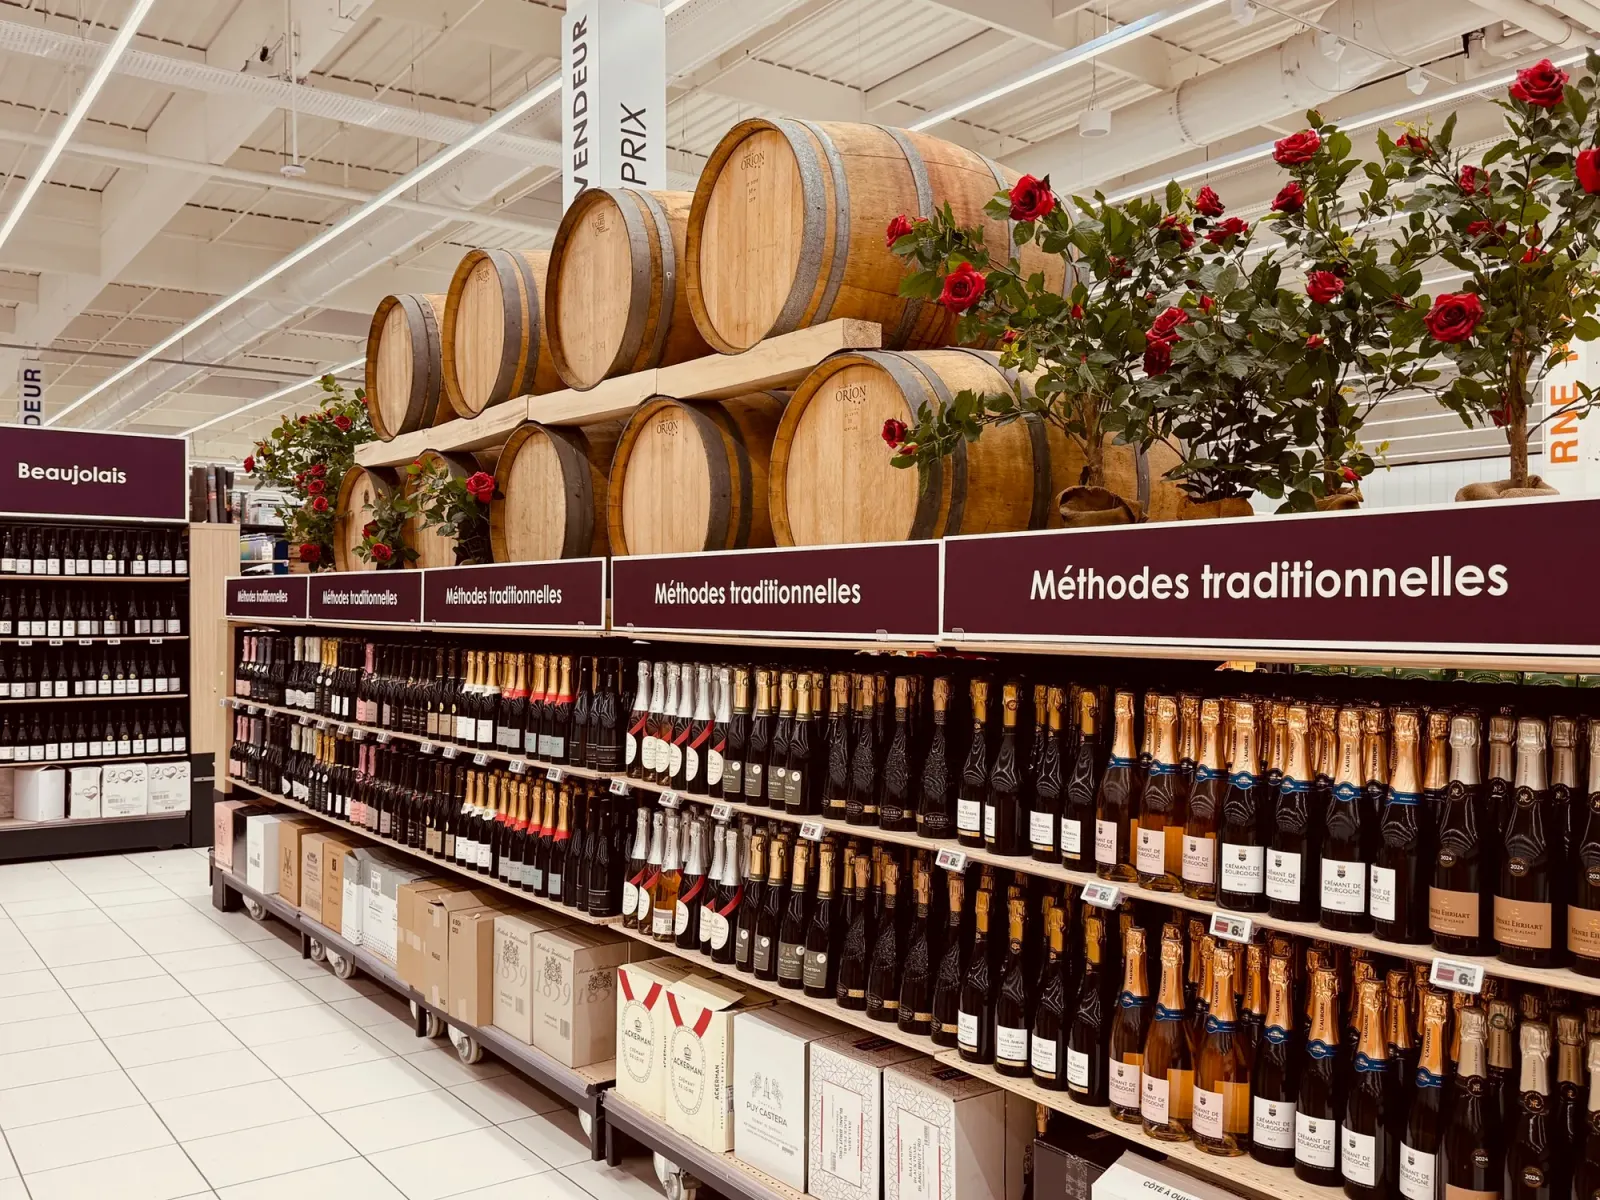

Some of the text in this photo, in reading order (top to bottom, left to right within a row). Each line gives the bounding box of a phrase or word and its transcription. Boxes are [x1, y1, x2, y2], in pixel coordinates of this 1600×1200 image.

[572, 14, 589, 200] VENDEUR
[620, 102, 647, 186] PRIX
[741, 151, 765, 170] ORION
[24, 368, 41, 426] DEUR
[836, 384, 867, 403] ORION
[656, 419, 679, 435] ORION
[18, 462, 127, 485] Beaujolais
[1030, 556, 1509, 600] Méthodes traditionnelles
[237, 588, 288, 603] Méthodes traditionnelles
[322, 588, 398, 606] Méthodes traditionnelles
[446, 584, 562, 605] Méthodes traditionnelles
[654, 578, 861, 605] Méthodes traditionnelles
[1225, 862, 1251, 871] CRÉMANT
[1225, 868, 1260, 877] BOURGOGNE
[1324, 879, 1351, 888] CRÉMANT
[1324, 886, 1360, 895] BOURGOGNE
[1442, 908, 1470, 919] EHRHART
[1496, 916, 1543, 930] HENRI EHRHART
[1572, 927, 1588, 938] HENRI
[624, 1029, 652, 1046] ACKERMAN
[674, 1057, 702, 1076] ACKERMAN
[746, 1101, 758, 1112] PUY
[759, 1107, 788, 1128] CASTERA
[1256, 1116, 1280, 1126] CRÉMANT
[1256, 1122, 1290, 1132] BOURGOGNE
[1297, 1138, 1330, 1150] BOURGOGNE
[1298, 1132, 1321, 1143] CRÉMANT
[1143, 1180, 1164, 1193] CÔTE
